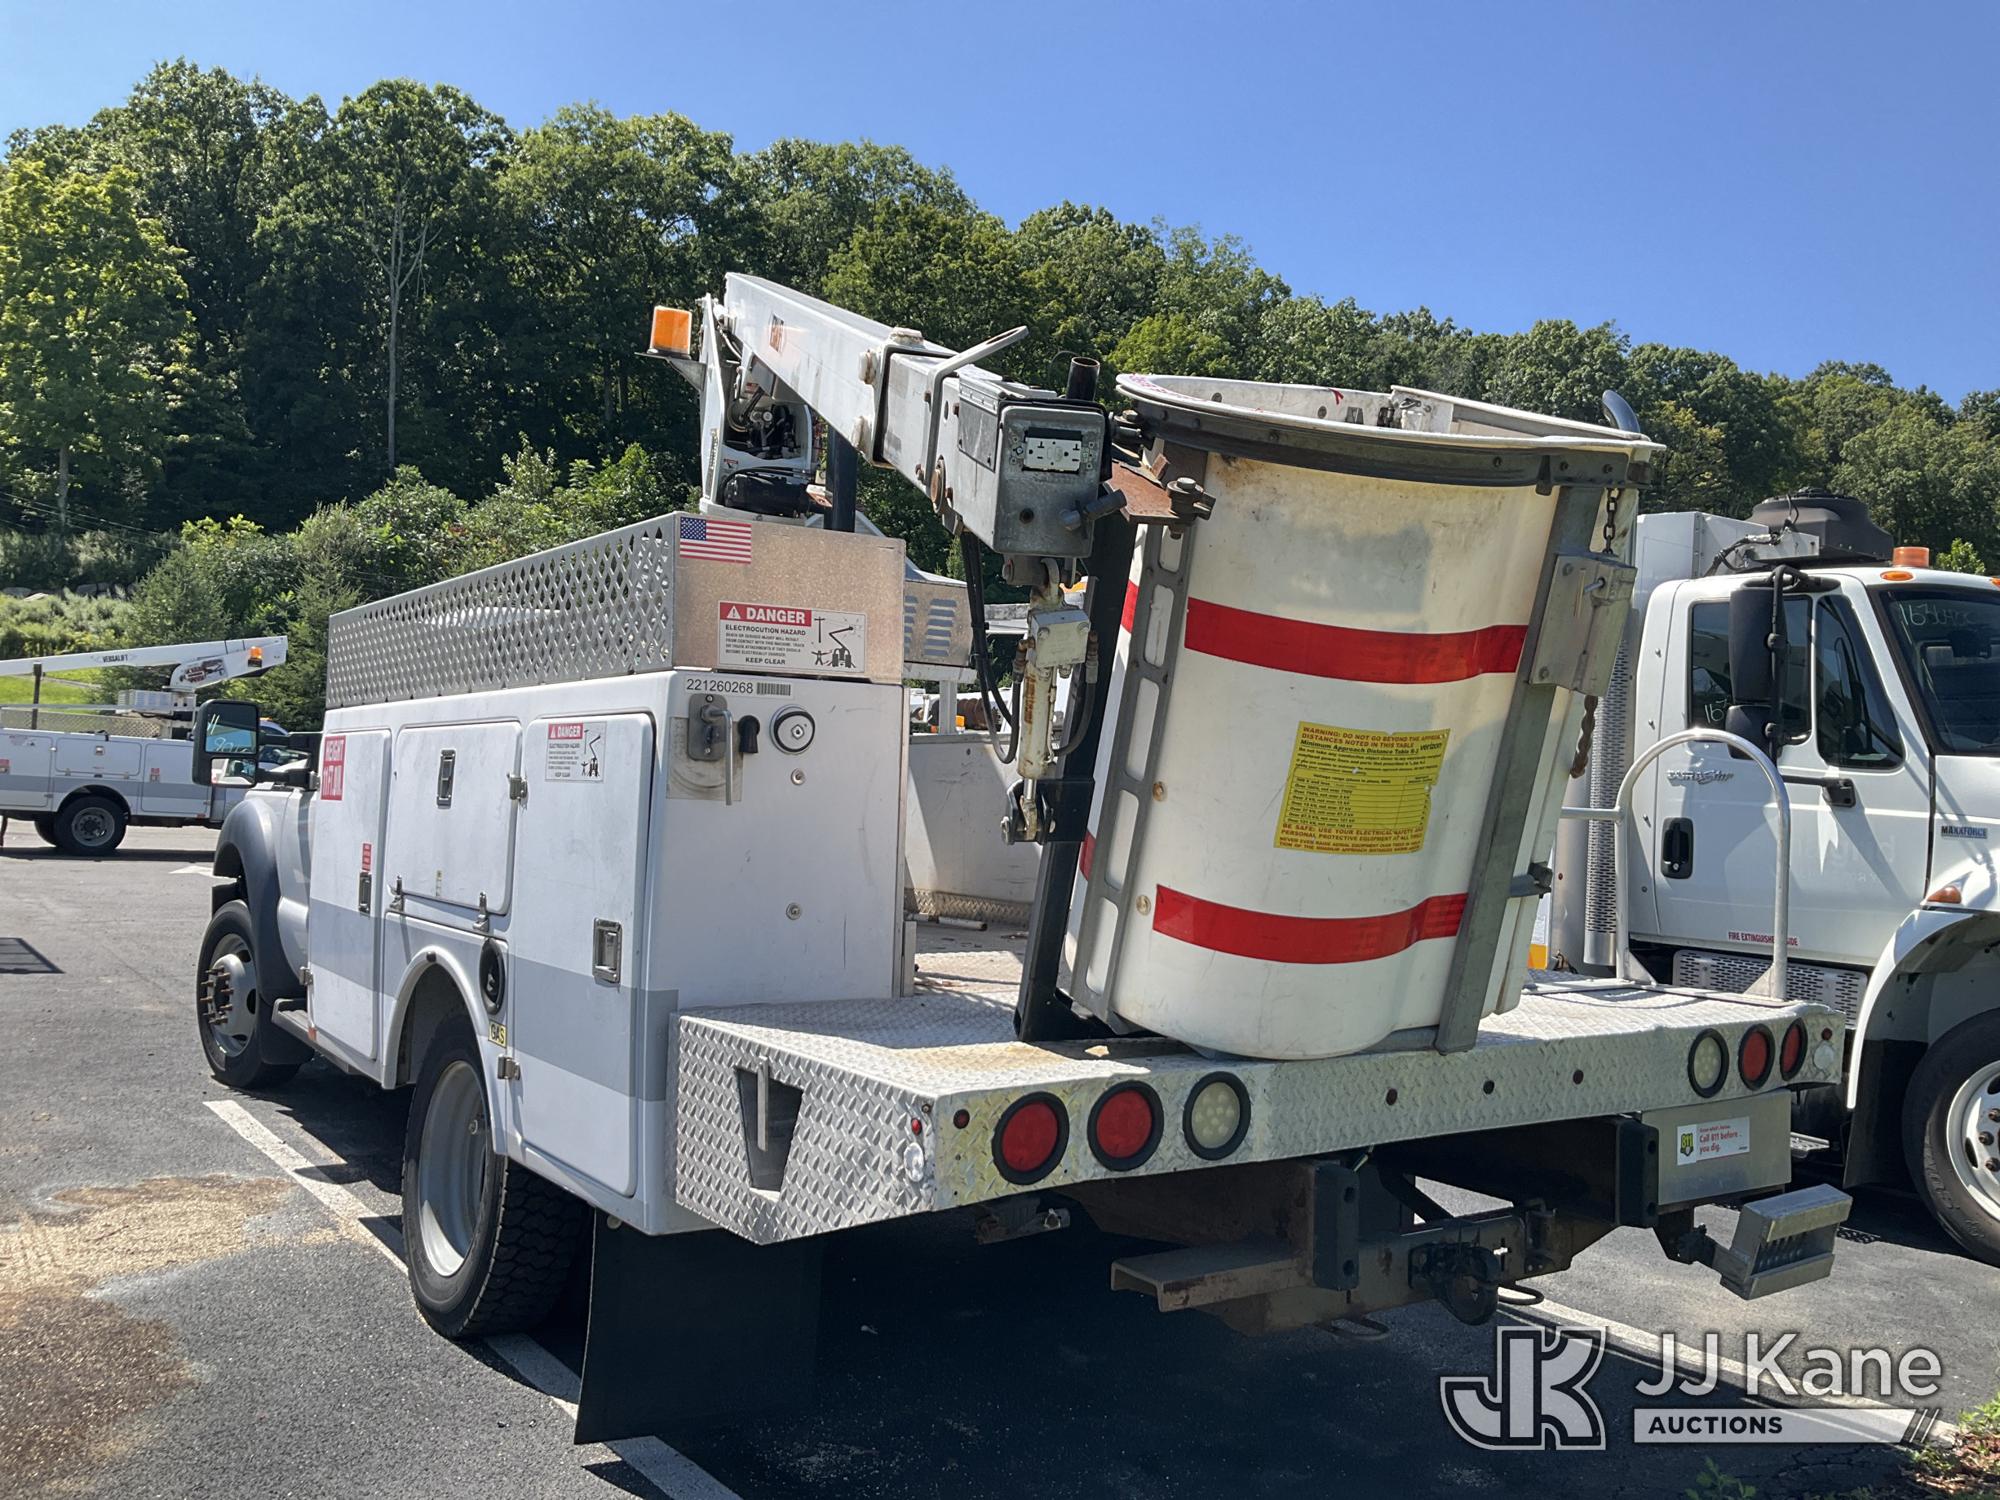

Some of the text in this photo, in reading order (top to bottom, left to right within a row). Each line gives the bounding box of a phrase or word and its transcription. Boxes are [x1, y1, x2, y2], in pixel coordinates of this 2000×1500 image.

[746, 607, 805, 624] DANGER
[726, 624, 779, 634] ELECTROCUTION
[686, 678, 754, 694] 221260268
[1303, 727, 1341, 737] WARNING:
[1302, 733, 1342, 744] DISTANCES
[1301, 740, 1331, 749] Minimum
[1333, 745, 1365, 753] Approach
[1421, 741, 1442, 750] verizon
[1282, 829, 1316, 837] PERSONAL
[1728, 932, 1740, 940] FIRE
[1741, 933, 1774, 944] EXTINGUISHE
[491, 1024, 504, 1044] GAS
[1681, 1132, 1694, 1149] 811
[1700, 1130, 1738, 1143] Call 811 before
[1700, 1146, 1710, 1156] you
